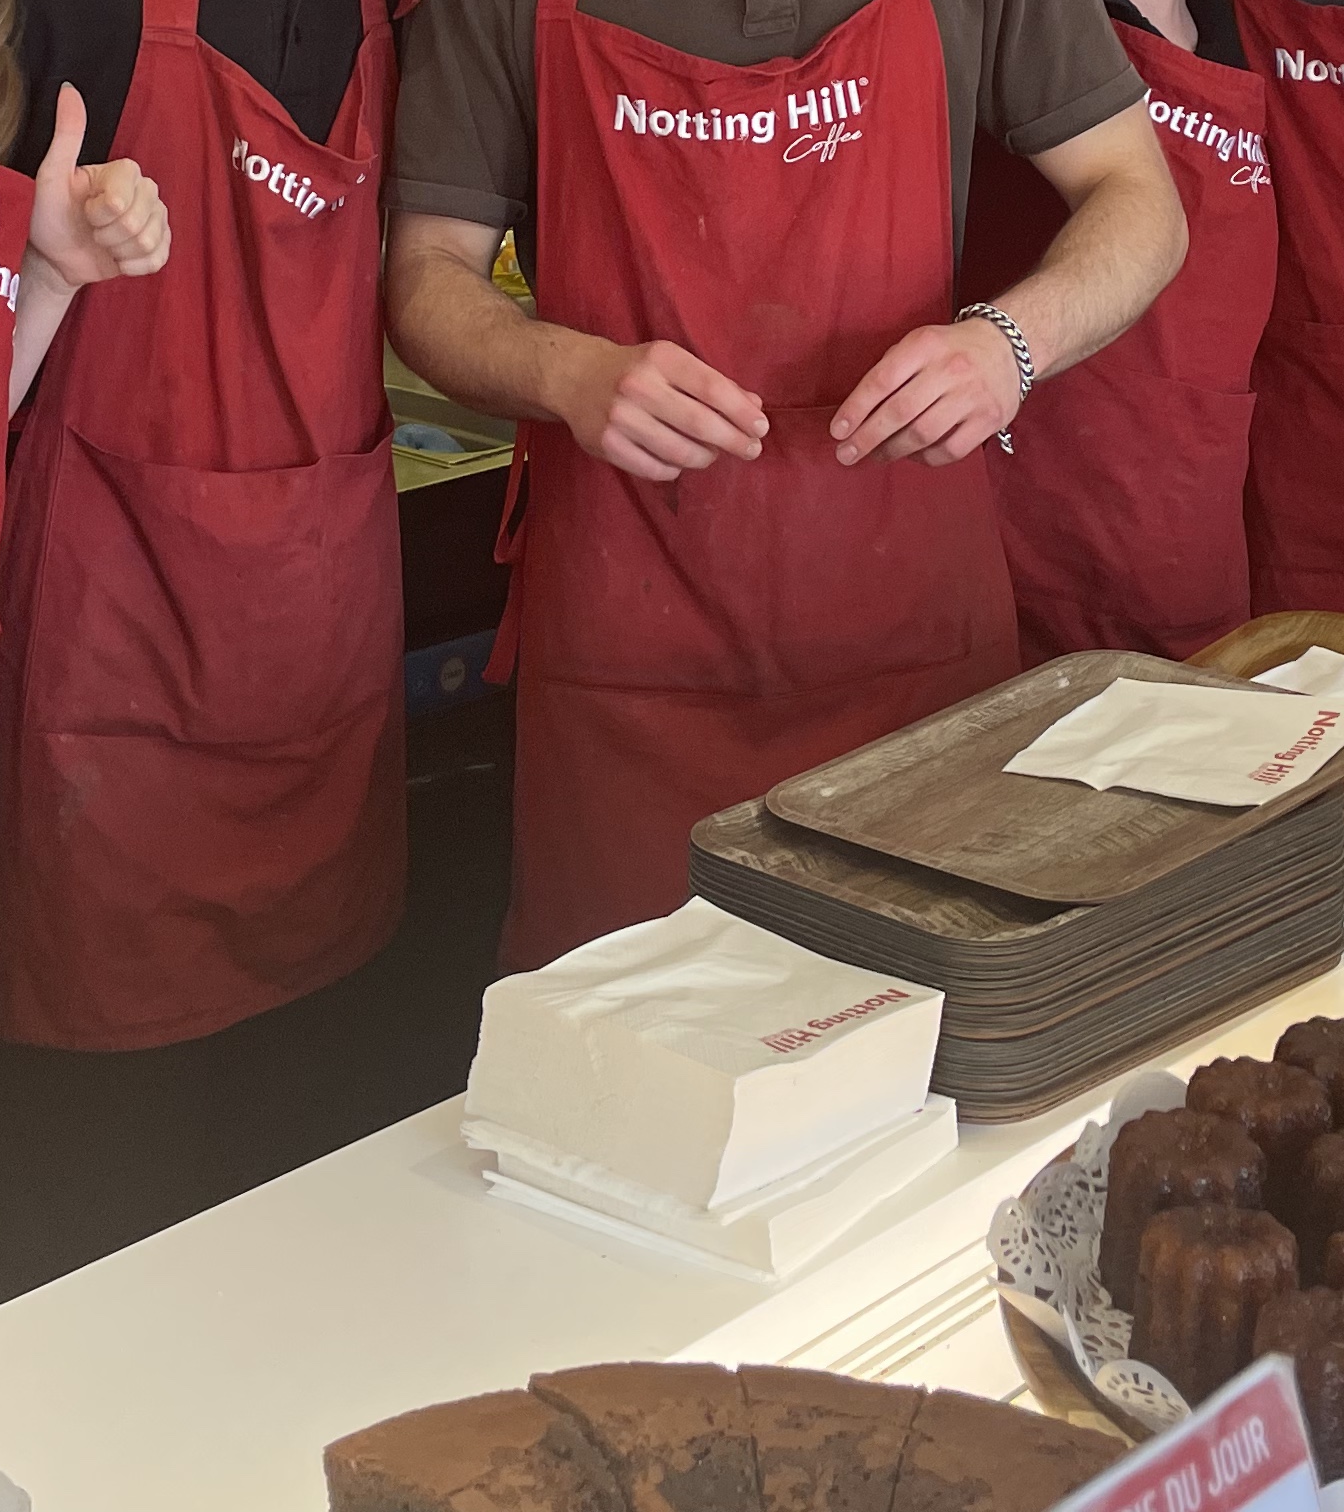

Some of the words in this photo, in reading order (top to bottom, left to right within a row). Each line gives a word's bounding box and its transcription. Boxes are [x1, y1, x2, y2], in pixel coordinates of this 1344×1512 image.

[614, 94, 776, 144] Notting
[787, 79, 861, 129] Hill
[783, 122, 862, 163] Coffee
[232, 137, 325, 219] Nottin
[1274, 710, 1340, 761] Notting
[1254, 763, 1294, 784] Hill
[808, 988, 911, 1030] Notting
[765, 1030, 821, 1054] Hill
[1209, 1416, 1270, 1496] JOUR
